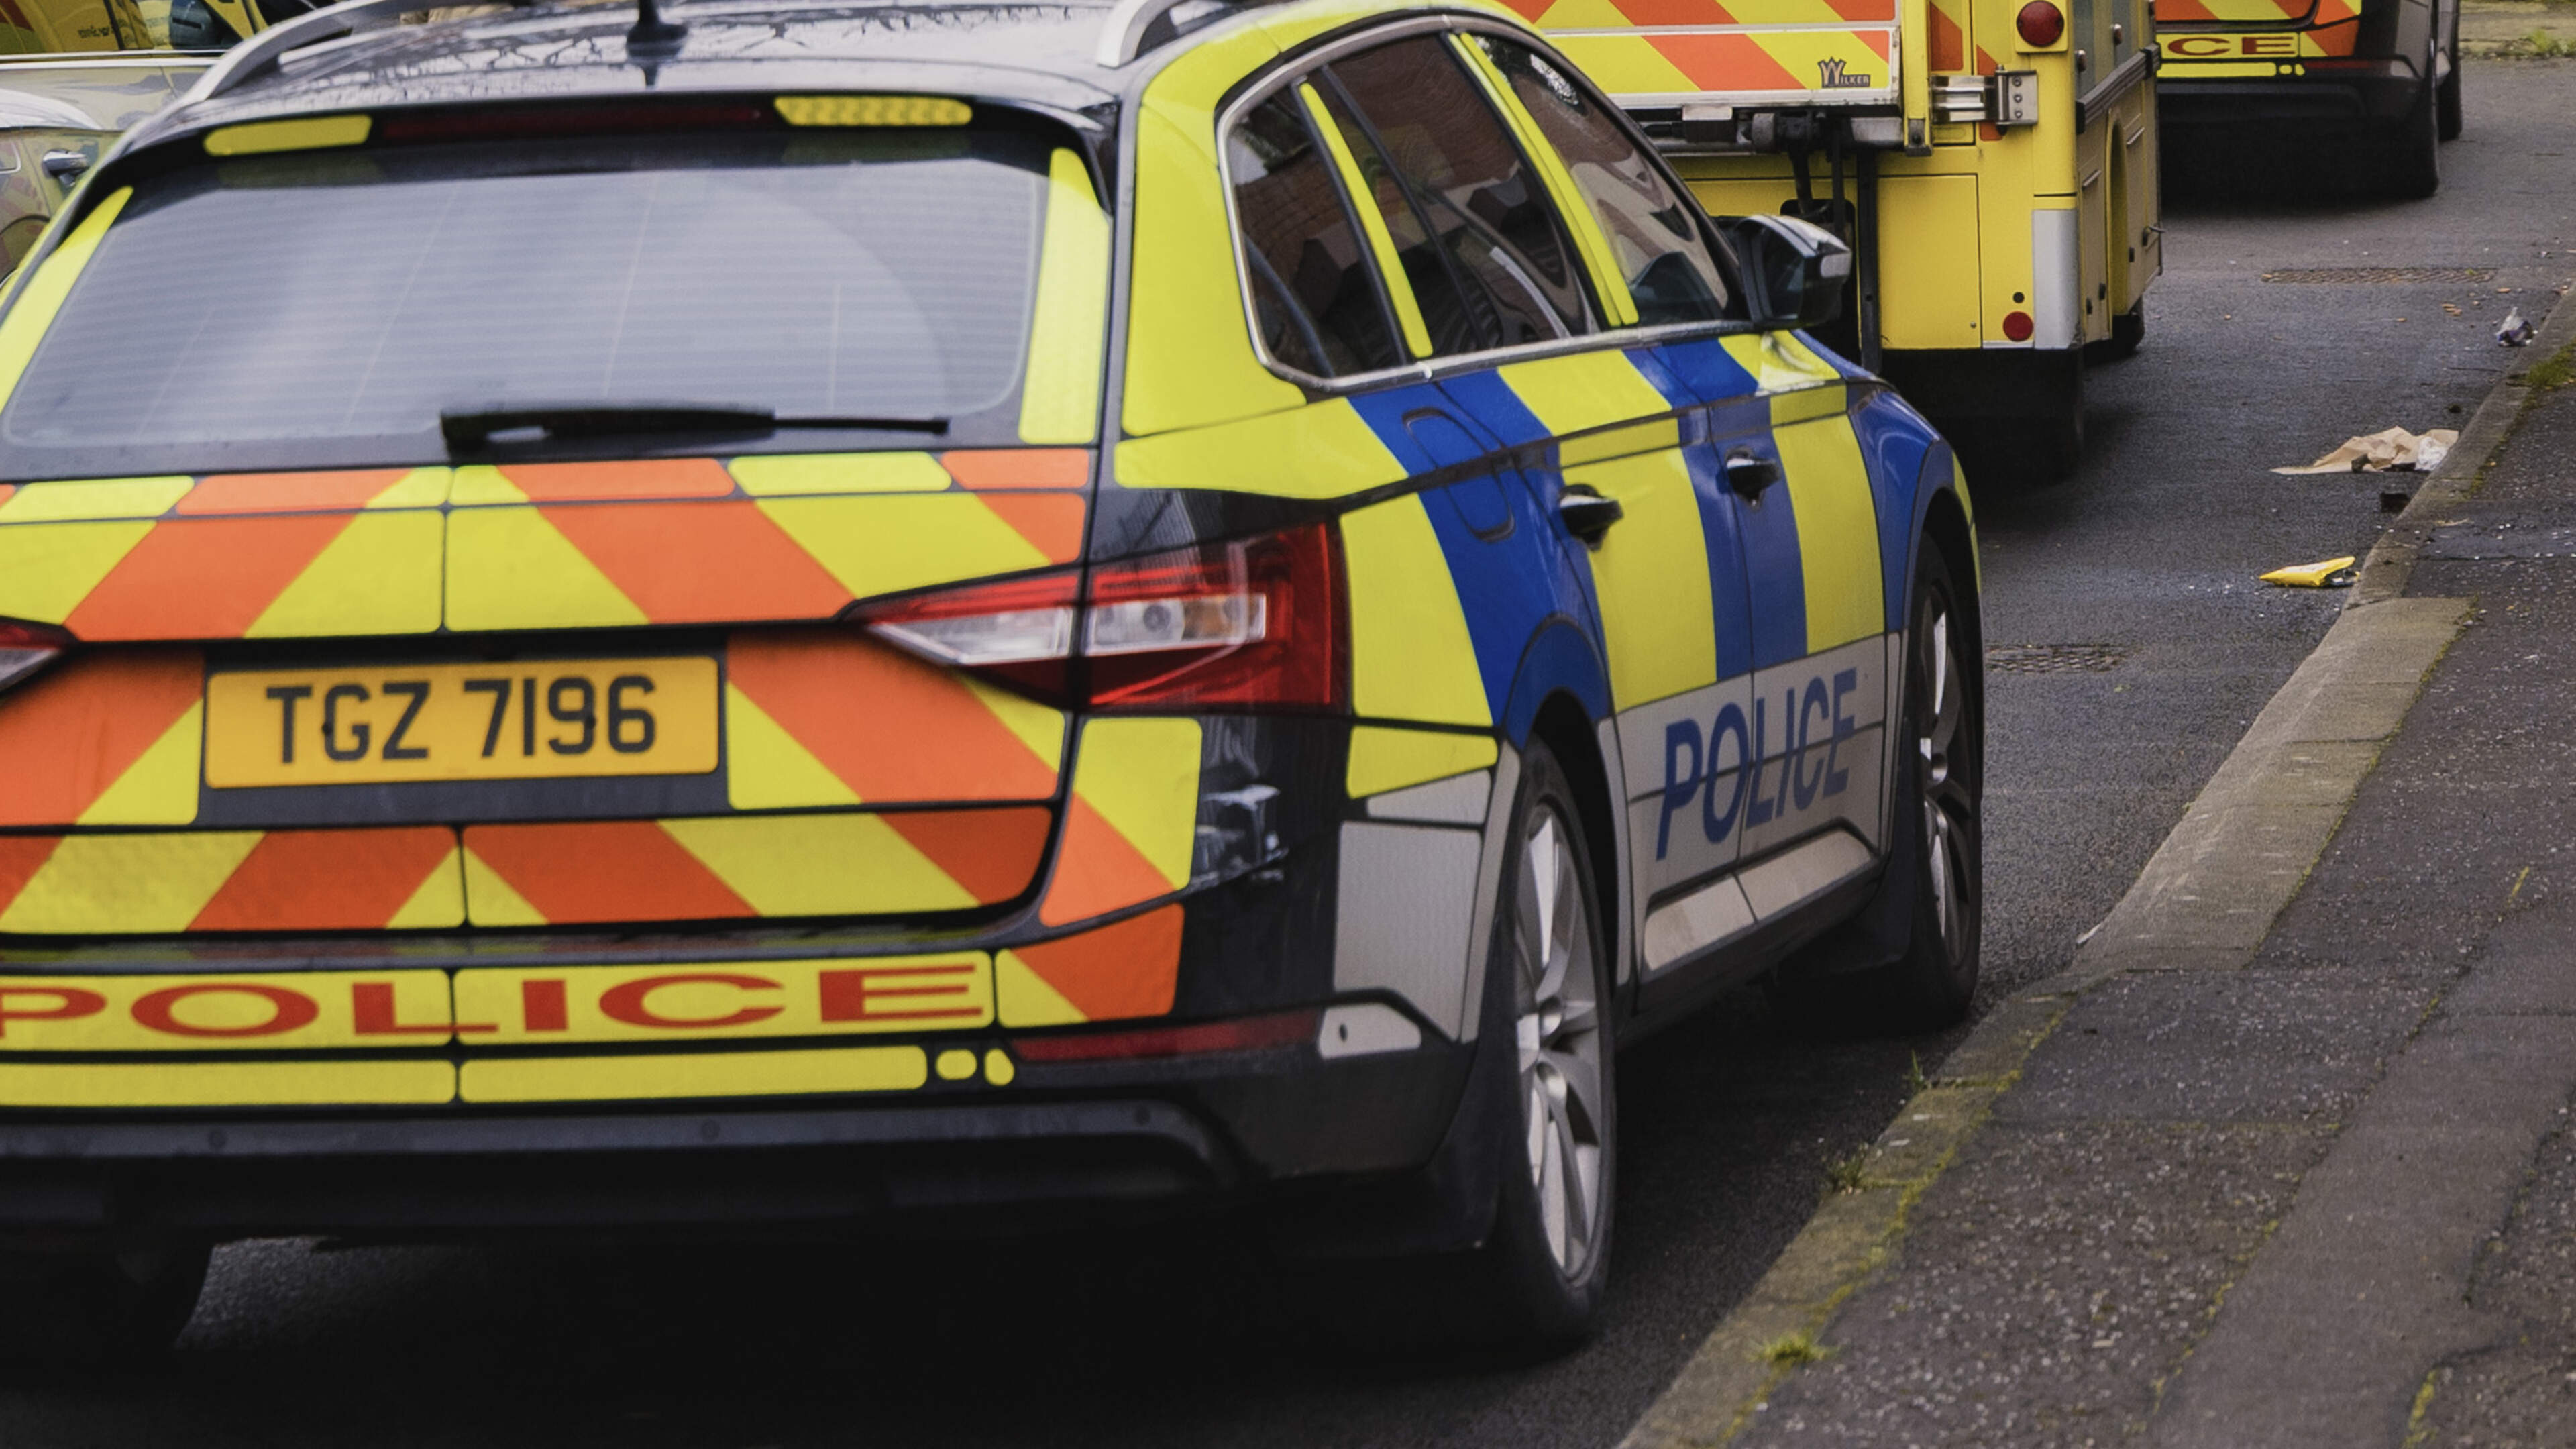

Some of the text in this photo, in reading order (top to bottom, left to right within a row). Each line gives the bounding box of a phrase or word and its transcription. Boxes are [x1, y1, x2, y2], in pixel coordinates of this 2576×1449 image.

[266, 674, 656, 763] TGZ 7196
[1656, 667, 1857, 861] POLICE
[0, 964, 983, 1038] POLICE
